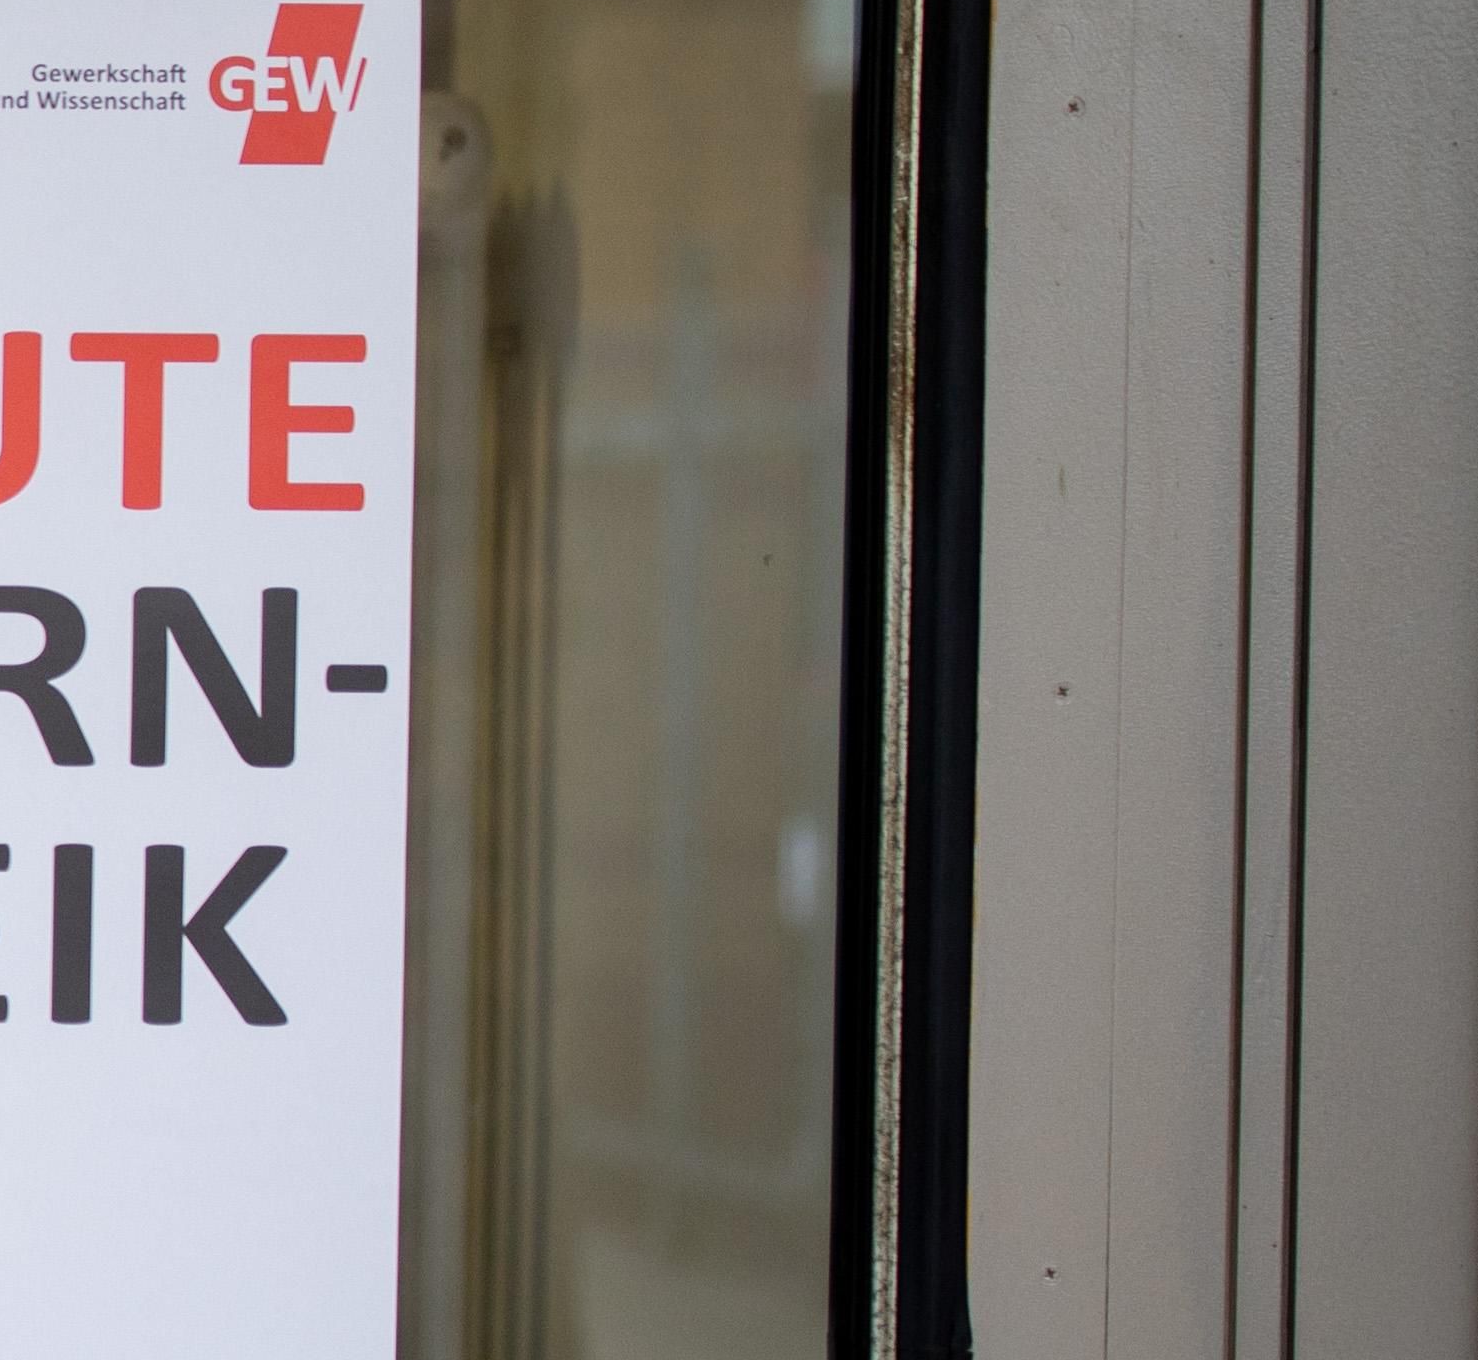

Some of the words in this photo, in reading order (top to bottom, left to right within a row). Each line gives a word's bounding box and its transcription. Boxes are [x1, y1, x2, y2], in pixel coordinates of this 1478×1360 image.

[31, 63, 187, 84] Gewerkschaft
[208, 56, 367, 113] GEW
[37, 90, 187, 111] Wissenschaft
